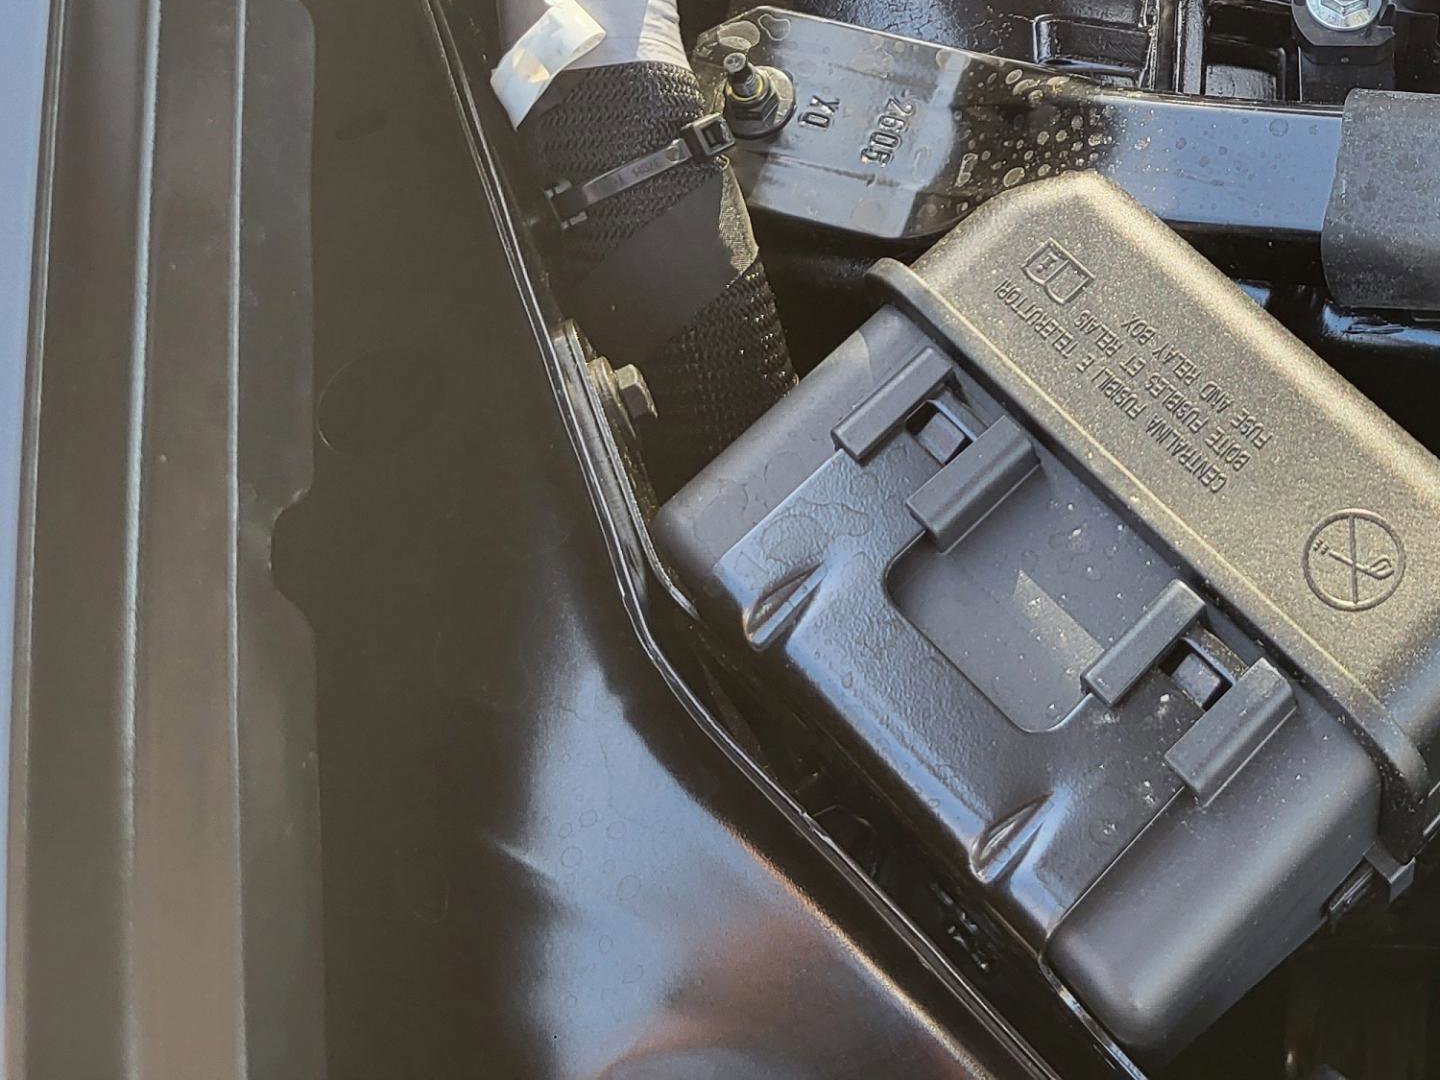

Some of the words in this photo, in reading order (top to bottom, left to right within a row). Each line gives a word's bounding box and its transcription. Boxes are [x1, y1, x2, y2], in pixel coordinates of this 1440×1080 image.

[993, 278, 1078, 360] TELERUTTORI
[1074, 309, 1123, 357] RELAIS
[1121, 312, 1156, 345] BOX
[1076, 353, 1096, 373] E
[1119, 350, 1147, 376] ET
[1151, 340, 1202, 386] RELAY
[1092, 366, 1147, 419] FUSIBILI
[1143, 371, 1209, 434] FUSIBLES
[1198, 380, 1234, 415] AND
[1204, 426, 1250, 472] BOITE
[1230, 407, 1273, 450] FUSE
[1145, 414, 1227, 493] CENTRALINA
